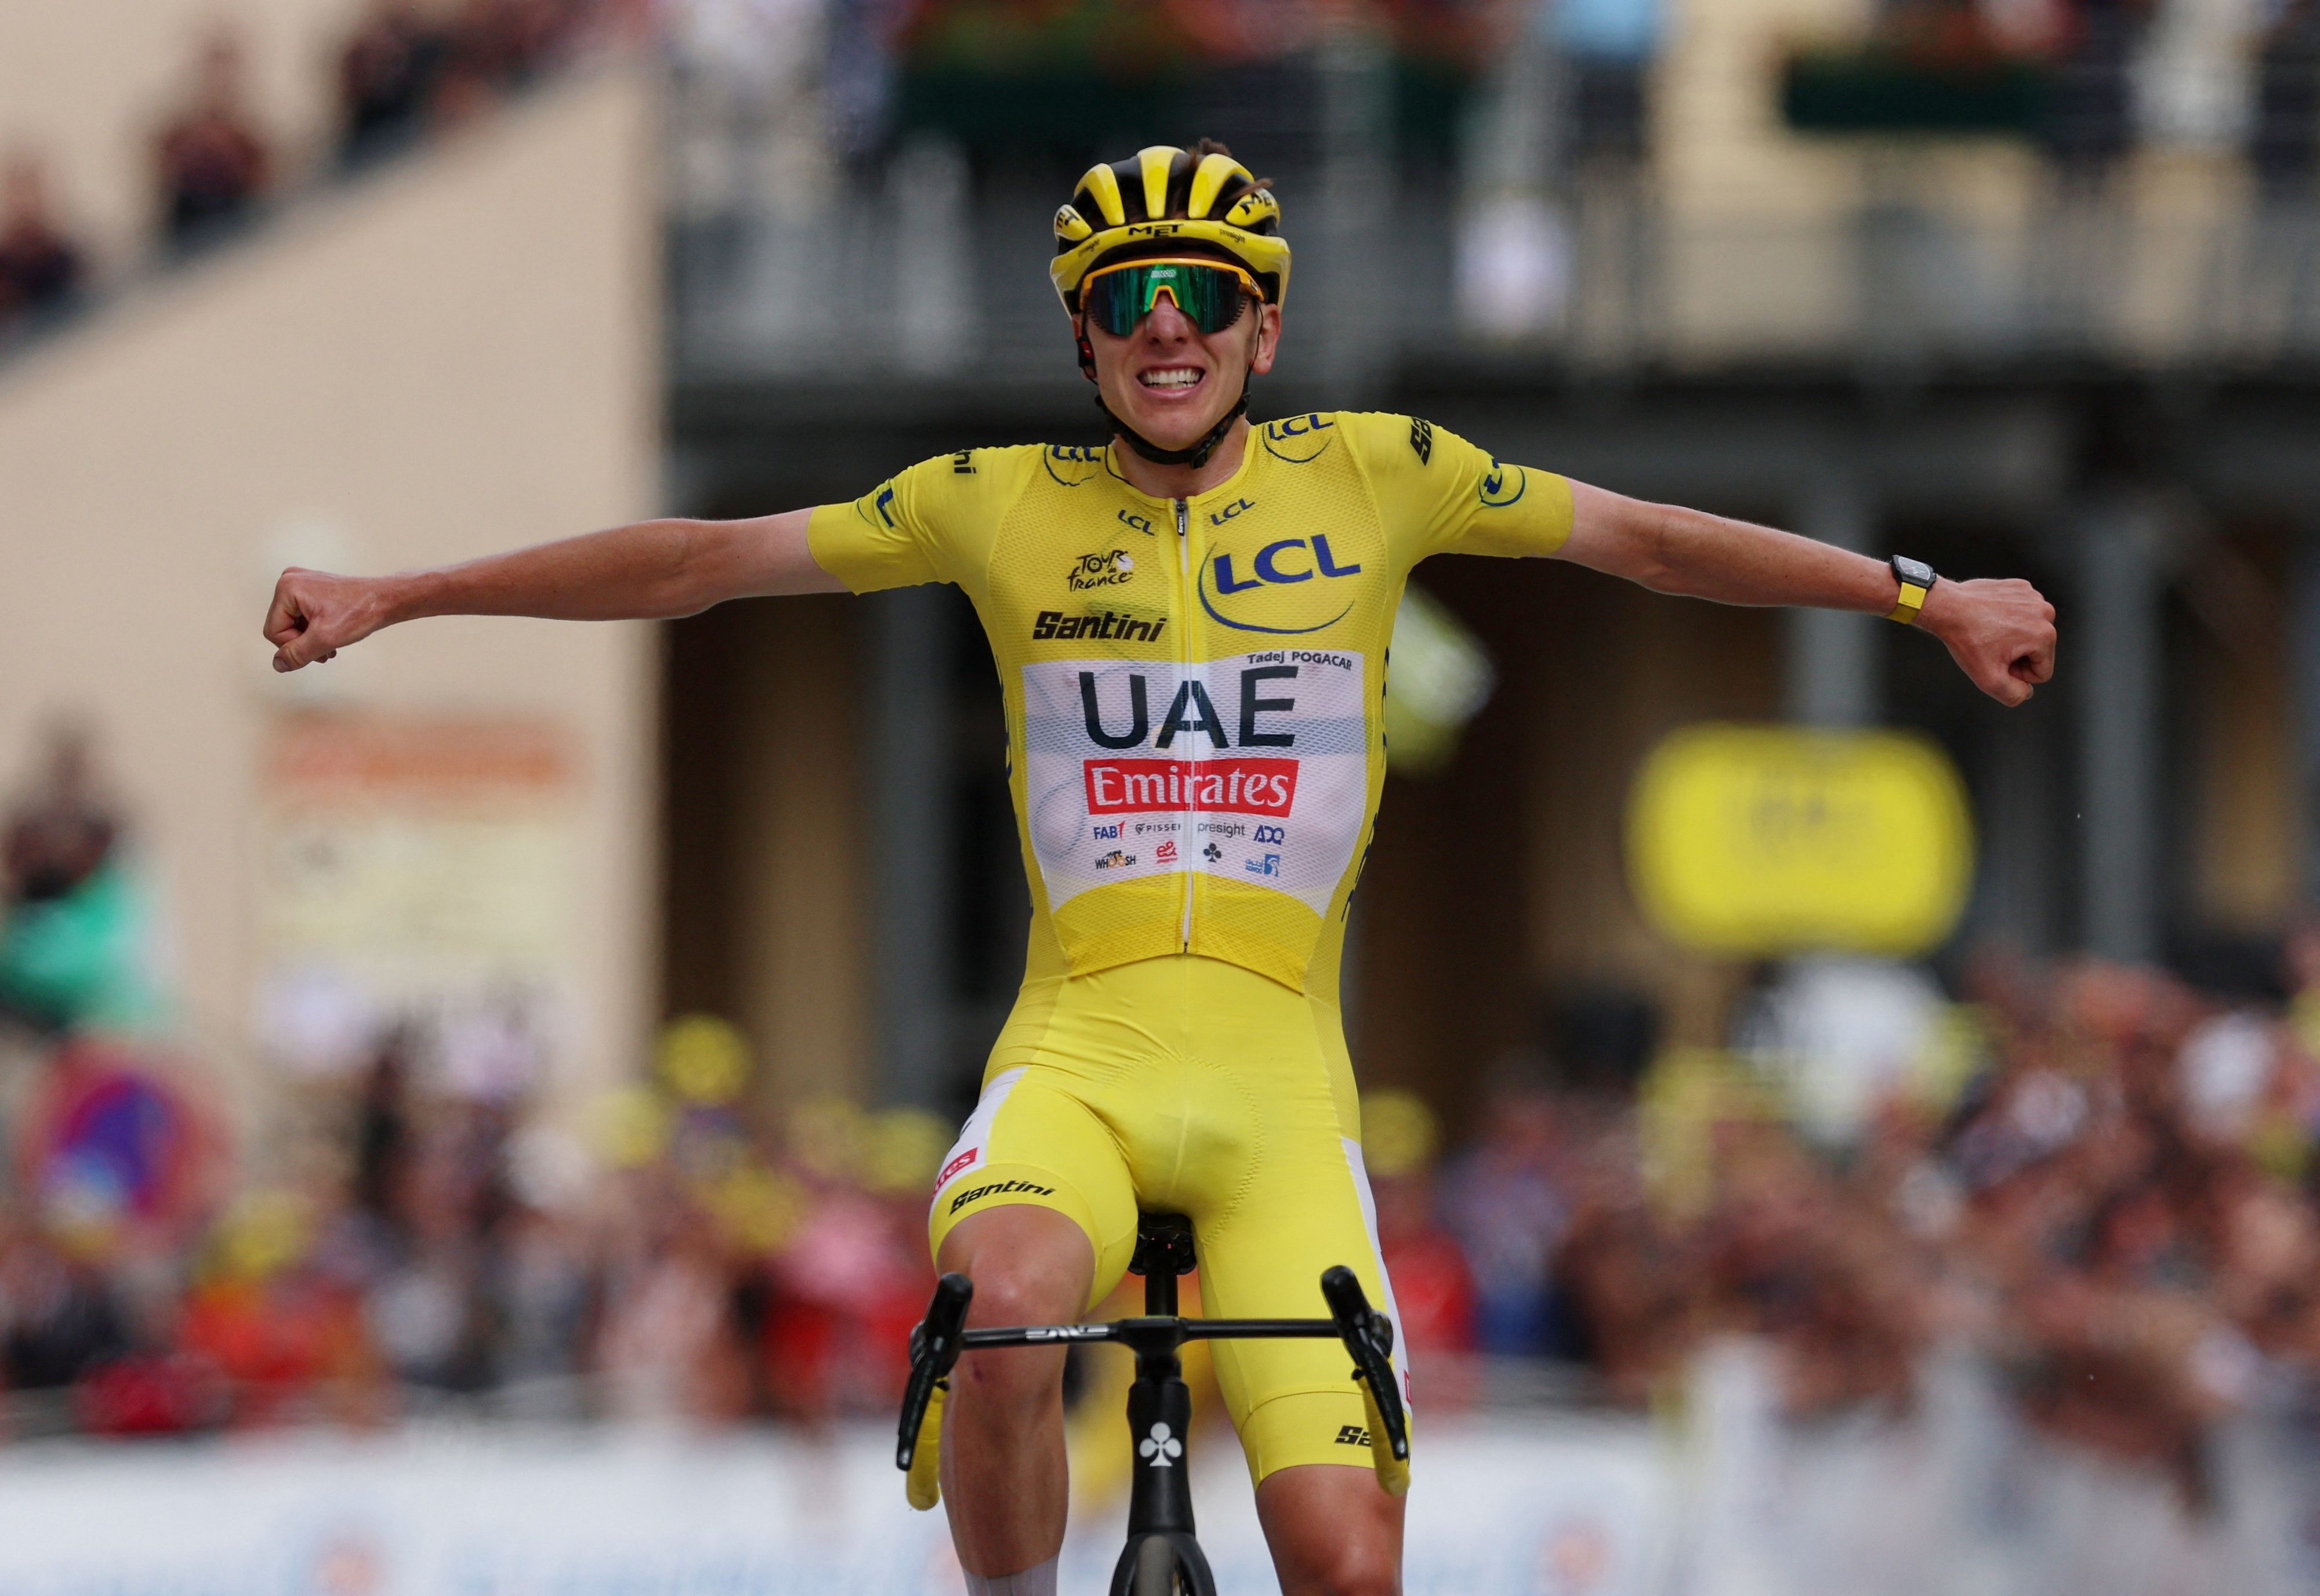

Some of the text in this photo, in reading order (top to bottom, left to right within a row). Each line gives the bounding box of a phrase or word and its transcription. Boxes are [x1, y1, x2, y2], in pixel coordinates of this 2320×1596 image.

[1129, 223, 1184, 238] MET
[1268, 414, 1333, 441] LCL
[1118, 509, 1155, 536] LCL
[1210, 498, 1255, 525] LCL
[1214, 534, 1361, 594] LCL
[1032, 611, 1167, 642] Santini
[1247, 651, 1353, 672] Tadej POGACAR
[1079, 666, 1299, 749] UAE
[1091, 765, 1289, 807] Emirates
[1146, 824, 1181, 832] PISSEI
[1198, 822, 1246, 838] presight
[1253, 825, 1285, 846] ADQ
[949, 1180, 1057, 1217] Santini
